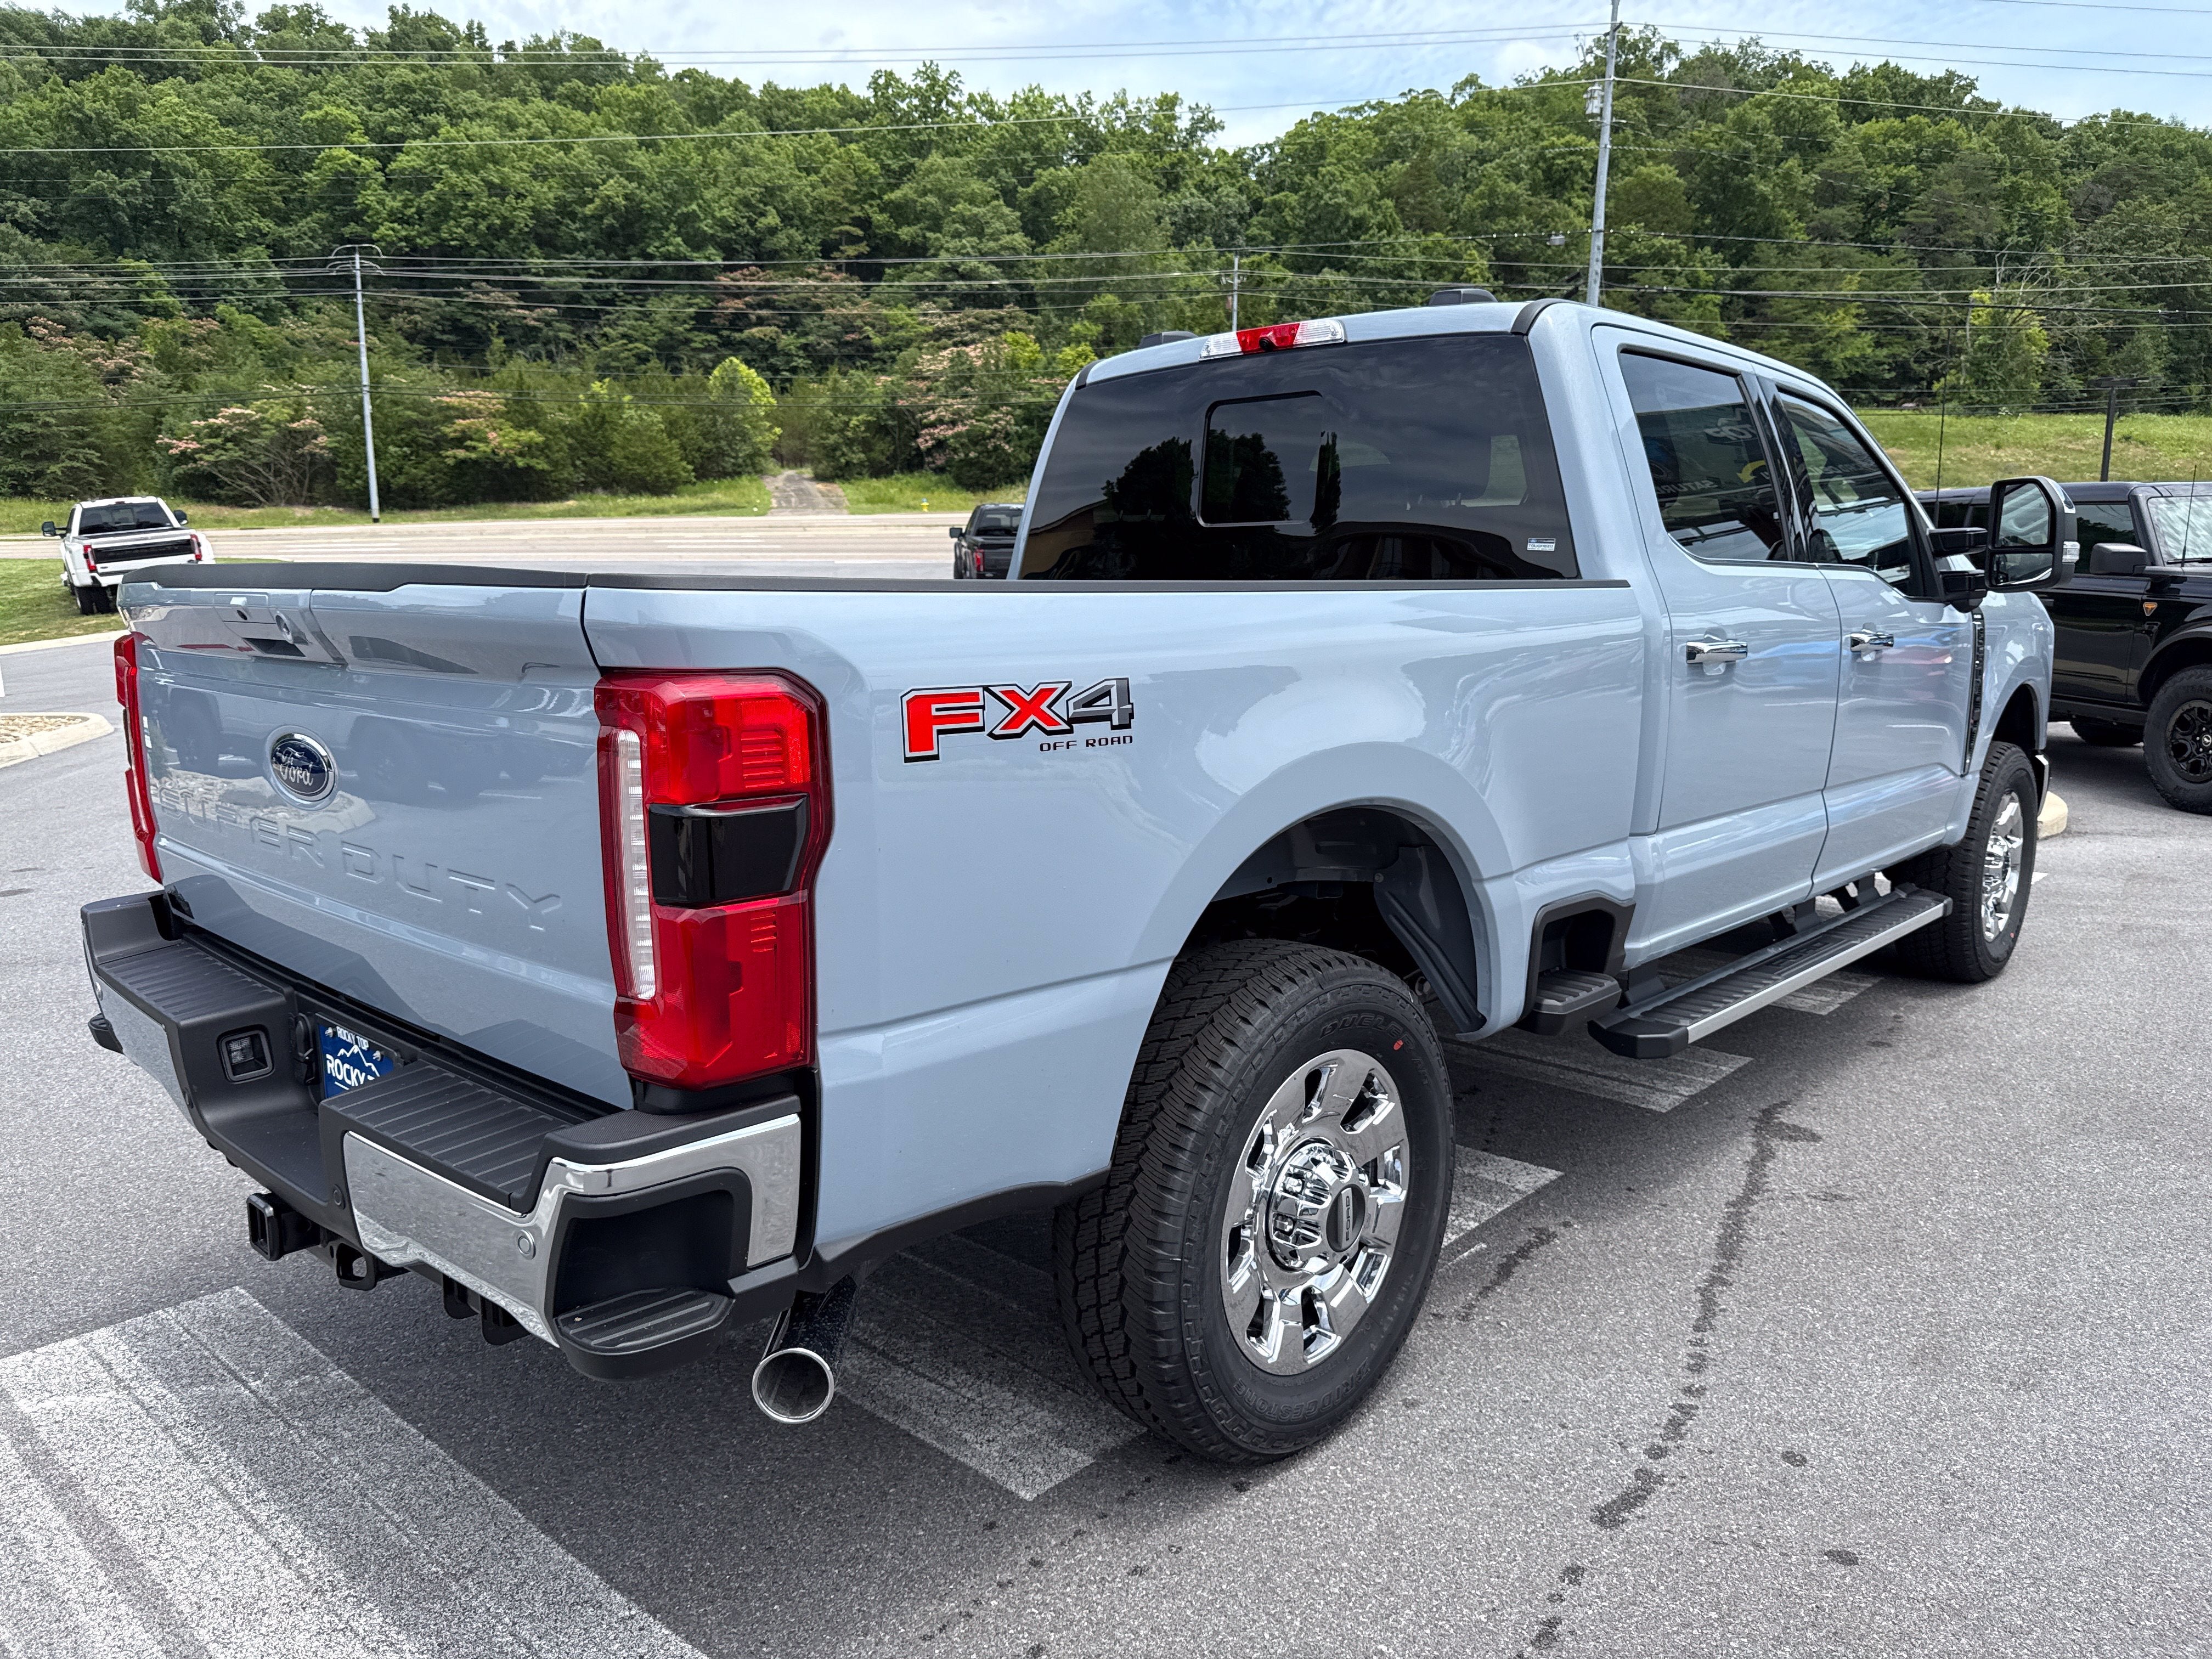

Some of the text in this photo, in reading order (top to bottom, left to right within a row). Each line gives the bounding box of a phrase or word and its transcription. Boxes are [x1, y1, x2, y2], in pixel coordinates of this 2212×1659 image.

[899, 677, 1135, 764] FX4
[1040, 735, 1133, 752] OFF ROAD
[279, 747, 314, 787] Ford
[158, 787, 564, 932] SUPER DUTY
[336, 1026, 369, 1051] ROCKY TOP
[1233, 1357, 1371, 1421] BRIDGESTONE
